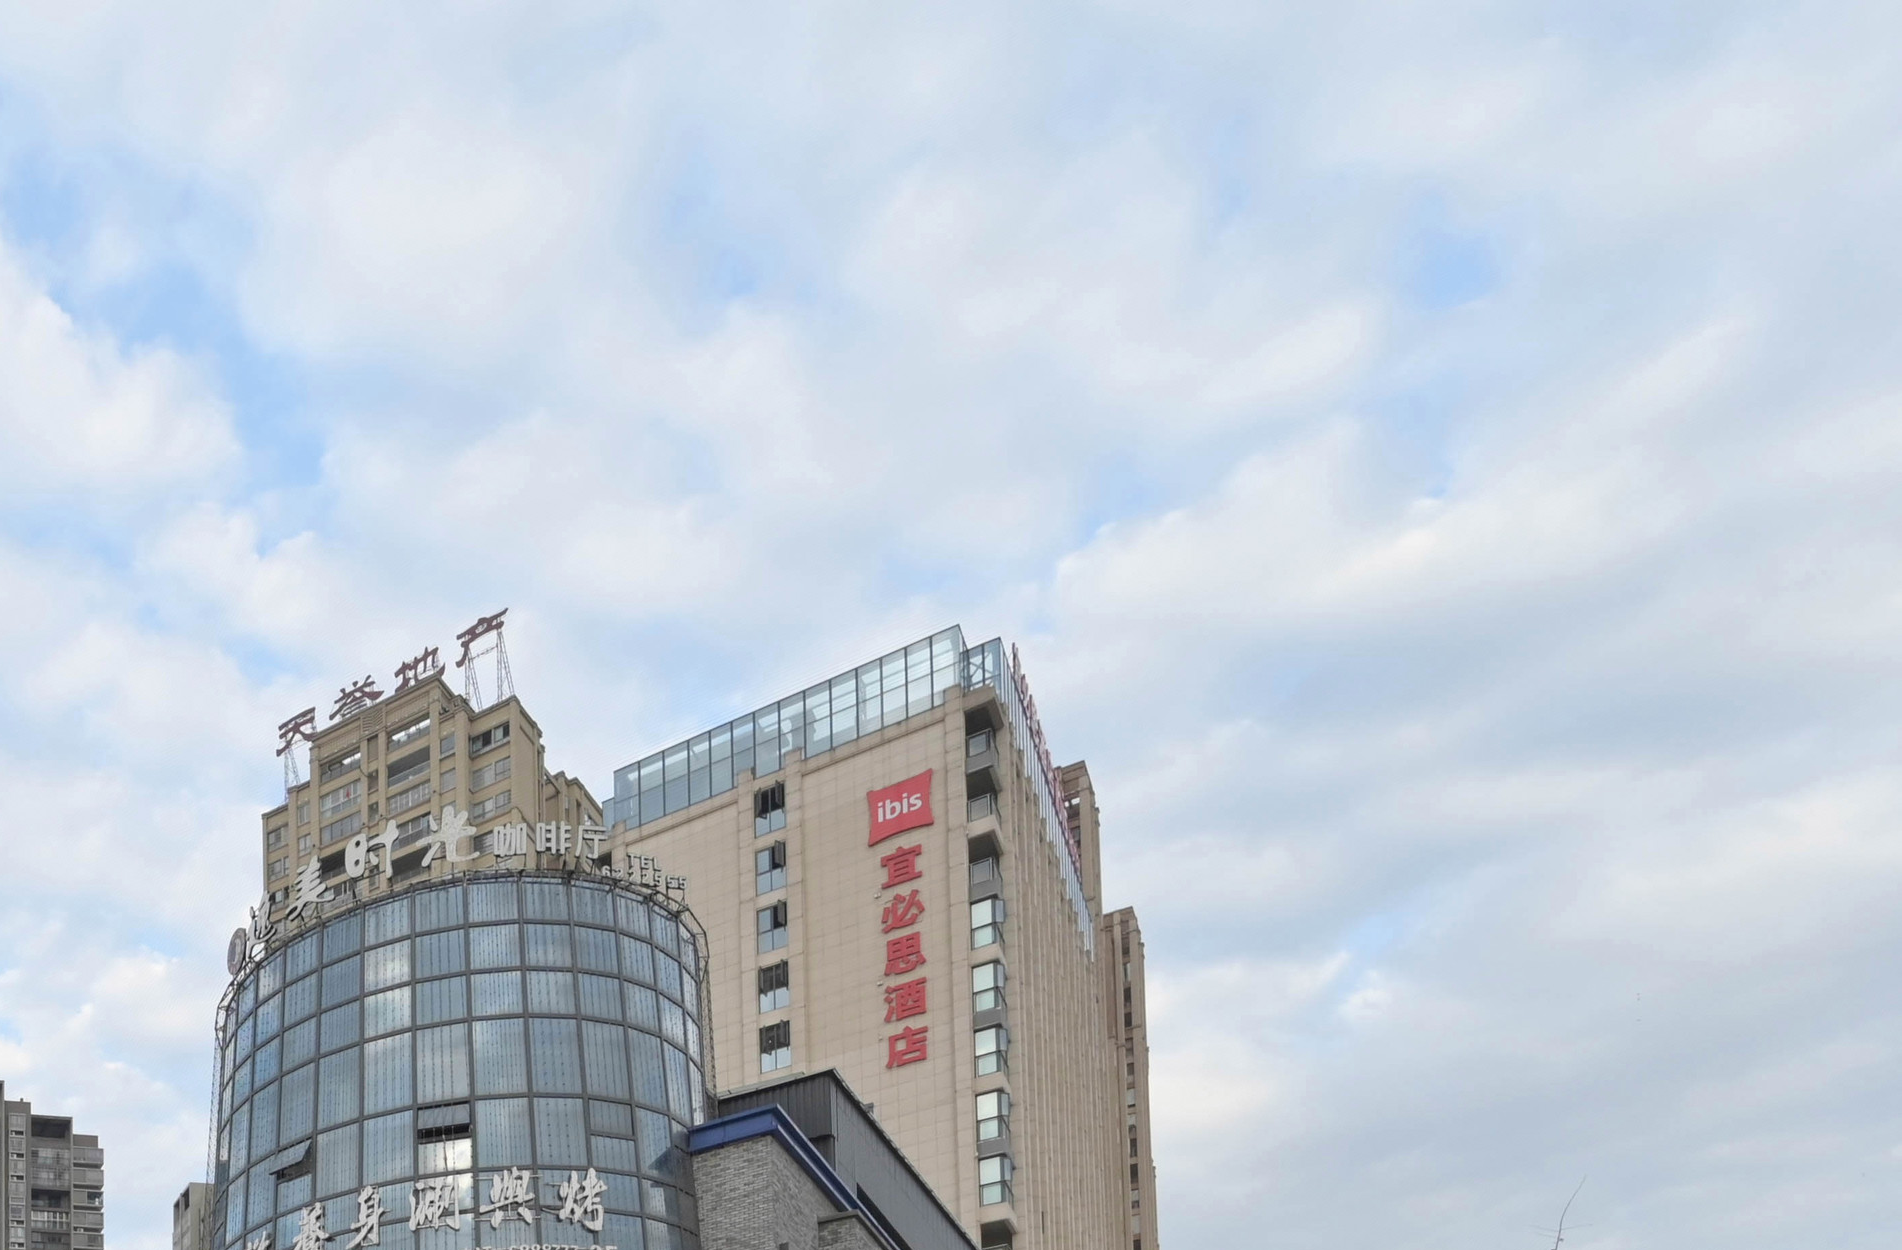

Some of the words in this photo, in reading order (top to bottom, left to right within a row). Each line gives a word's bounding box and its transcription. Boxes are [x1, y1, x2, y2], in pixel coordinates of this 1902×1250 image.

[276, 608, 509, 757] 天誉地产
[877, 793, 922, 823] ibis
[494, 821, 608, 859] 咖啡厅
[627, 853, 661, 871] TEL
[880, 844, 929, 1069] 宜必思酒店
